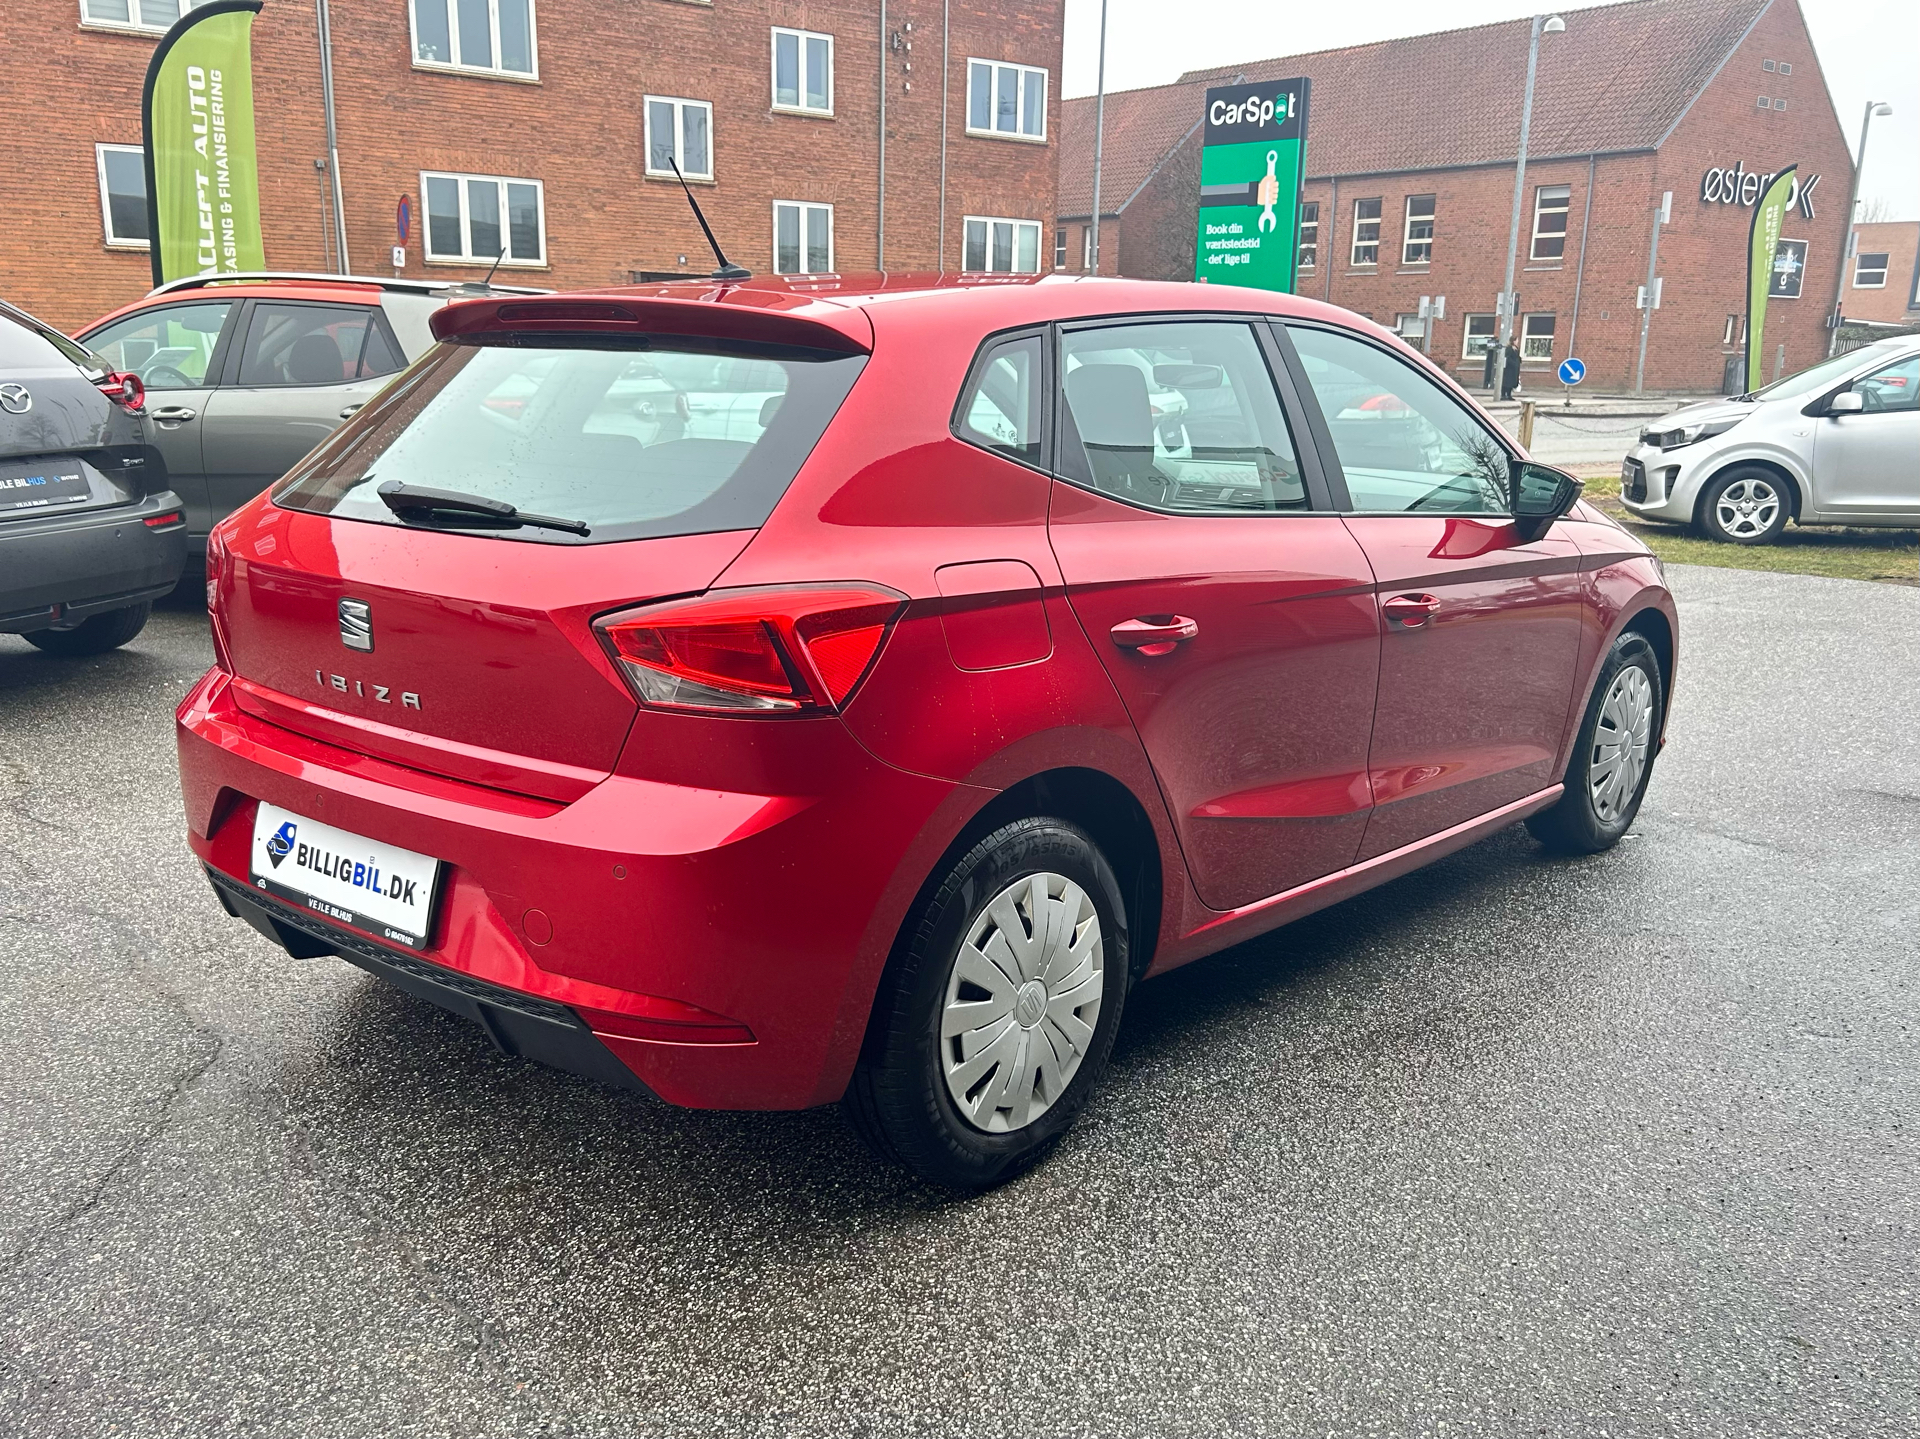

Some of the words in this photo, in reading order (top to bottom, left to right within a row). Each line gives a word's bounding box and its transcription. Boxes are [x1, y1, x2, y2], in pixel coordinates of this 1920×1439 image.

[187, 65, 208, 161] AUTO
[210, 69, 231, 198] FINANSIERING
[220, 202, 233, 214] &
[1206, 223, 1227, 235] Book
[1228, 223, 1243, 234] din
[1205, 238, 1260, 250] værkstedstid
[1224, 253, 1240, 266] lige
[1240, 253, 1250, 264] til
[14, 476, 47, 488] BILHUS
[315, 669, 422, 711] IBIZA
[296, 842, 418, 907] BILLIGBIL.DK
[308, 898, 330, 914] VEJLE
[330, 906, 353, 923] BILHUS
